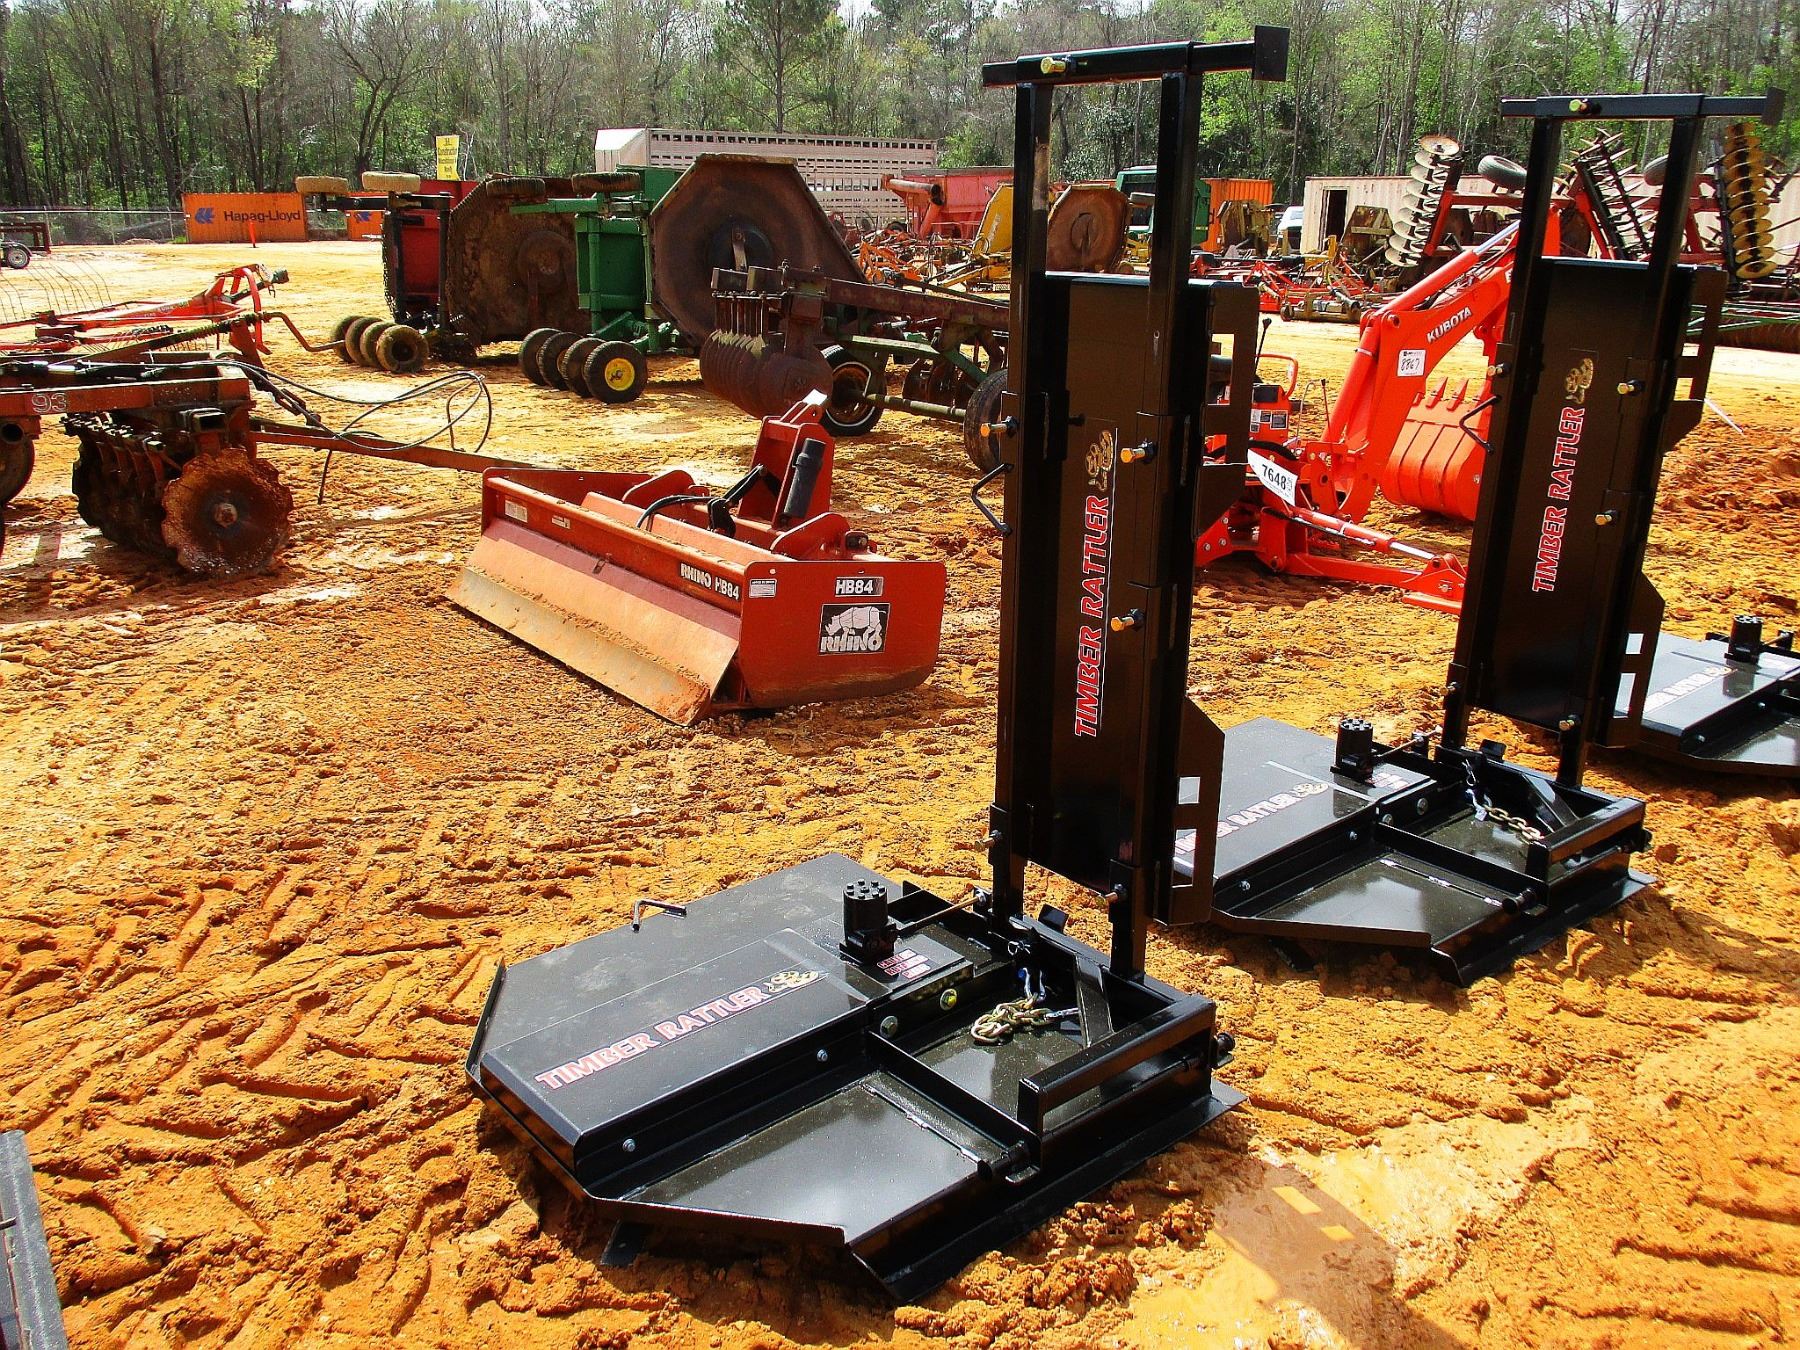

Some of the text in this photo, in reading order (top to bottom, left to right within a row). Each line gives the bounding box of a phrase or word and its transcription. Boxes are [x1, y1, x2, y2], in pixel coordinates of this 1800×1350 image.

[224, 210, 301, 223] Hapag-Lloyd
[1426, 306, 1472, 343] KUBOTA
[1400, 357, 1420, 372] 8867
[31, 392, 67, 413] 93
[1261, 463, 1287, 490] 7648
[1532, 406, 1585, 592] TIMBER RATTLER
[680, 562, 712, 588] RHINO
[714, 576, 740, 600] HB84
[835, 579, 874, 595] HB84
[1075, 495, 1109, 737] TIMBER RATTLER
[534, 986, 772, 1090] TIMBER RATTLER
